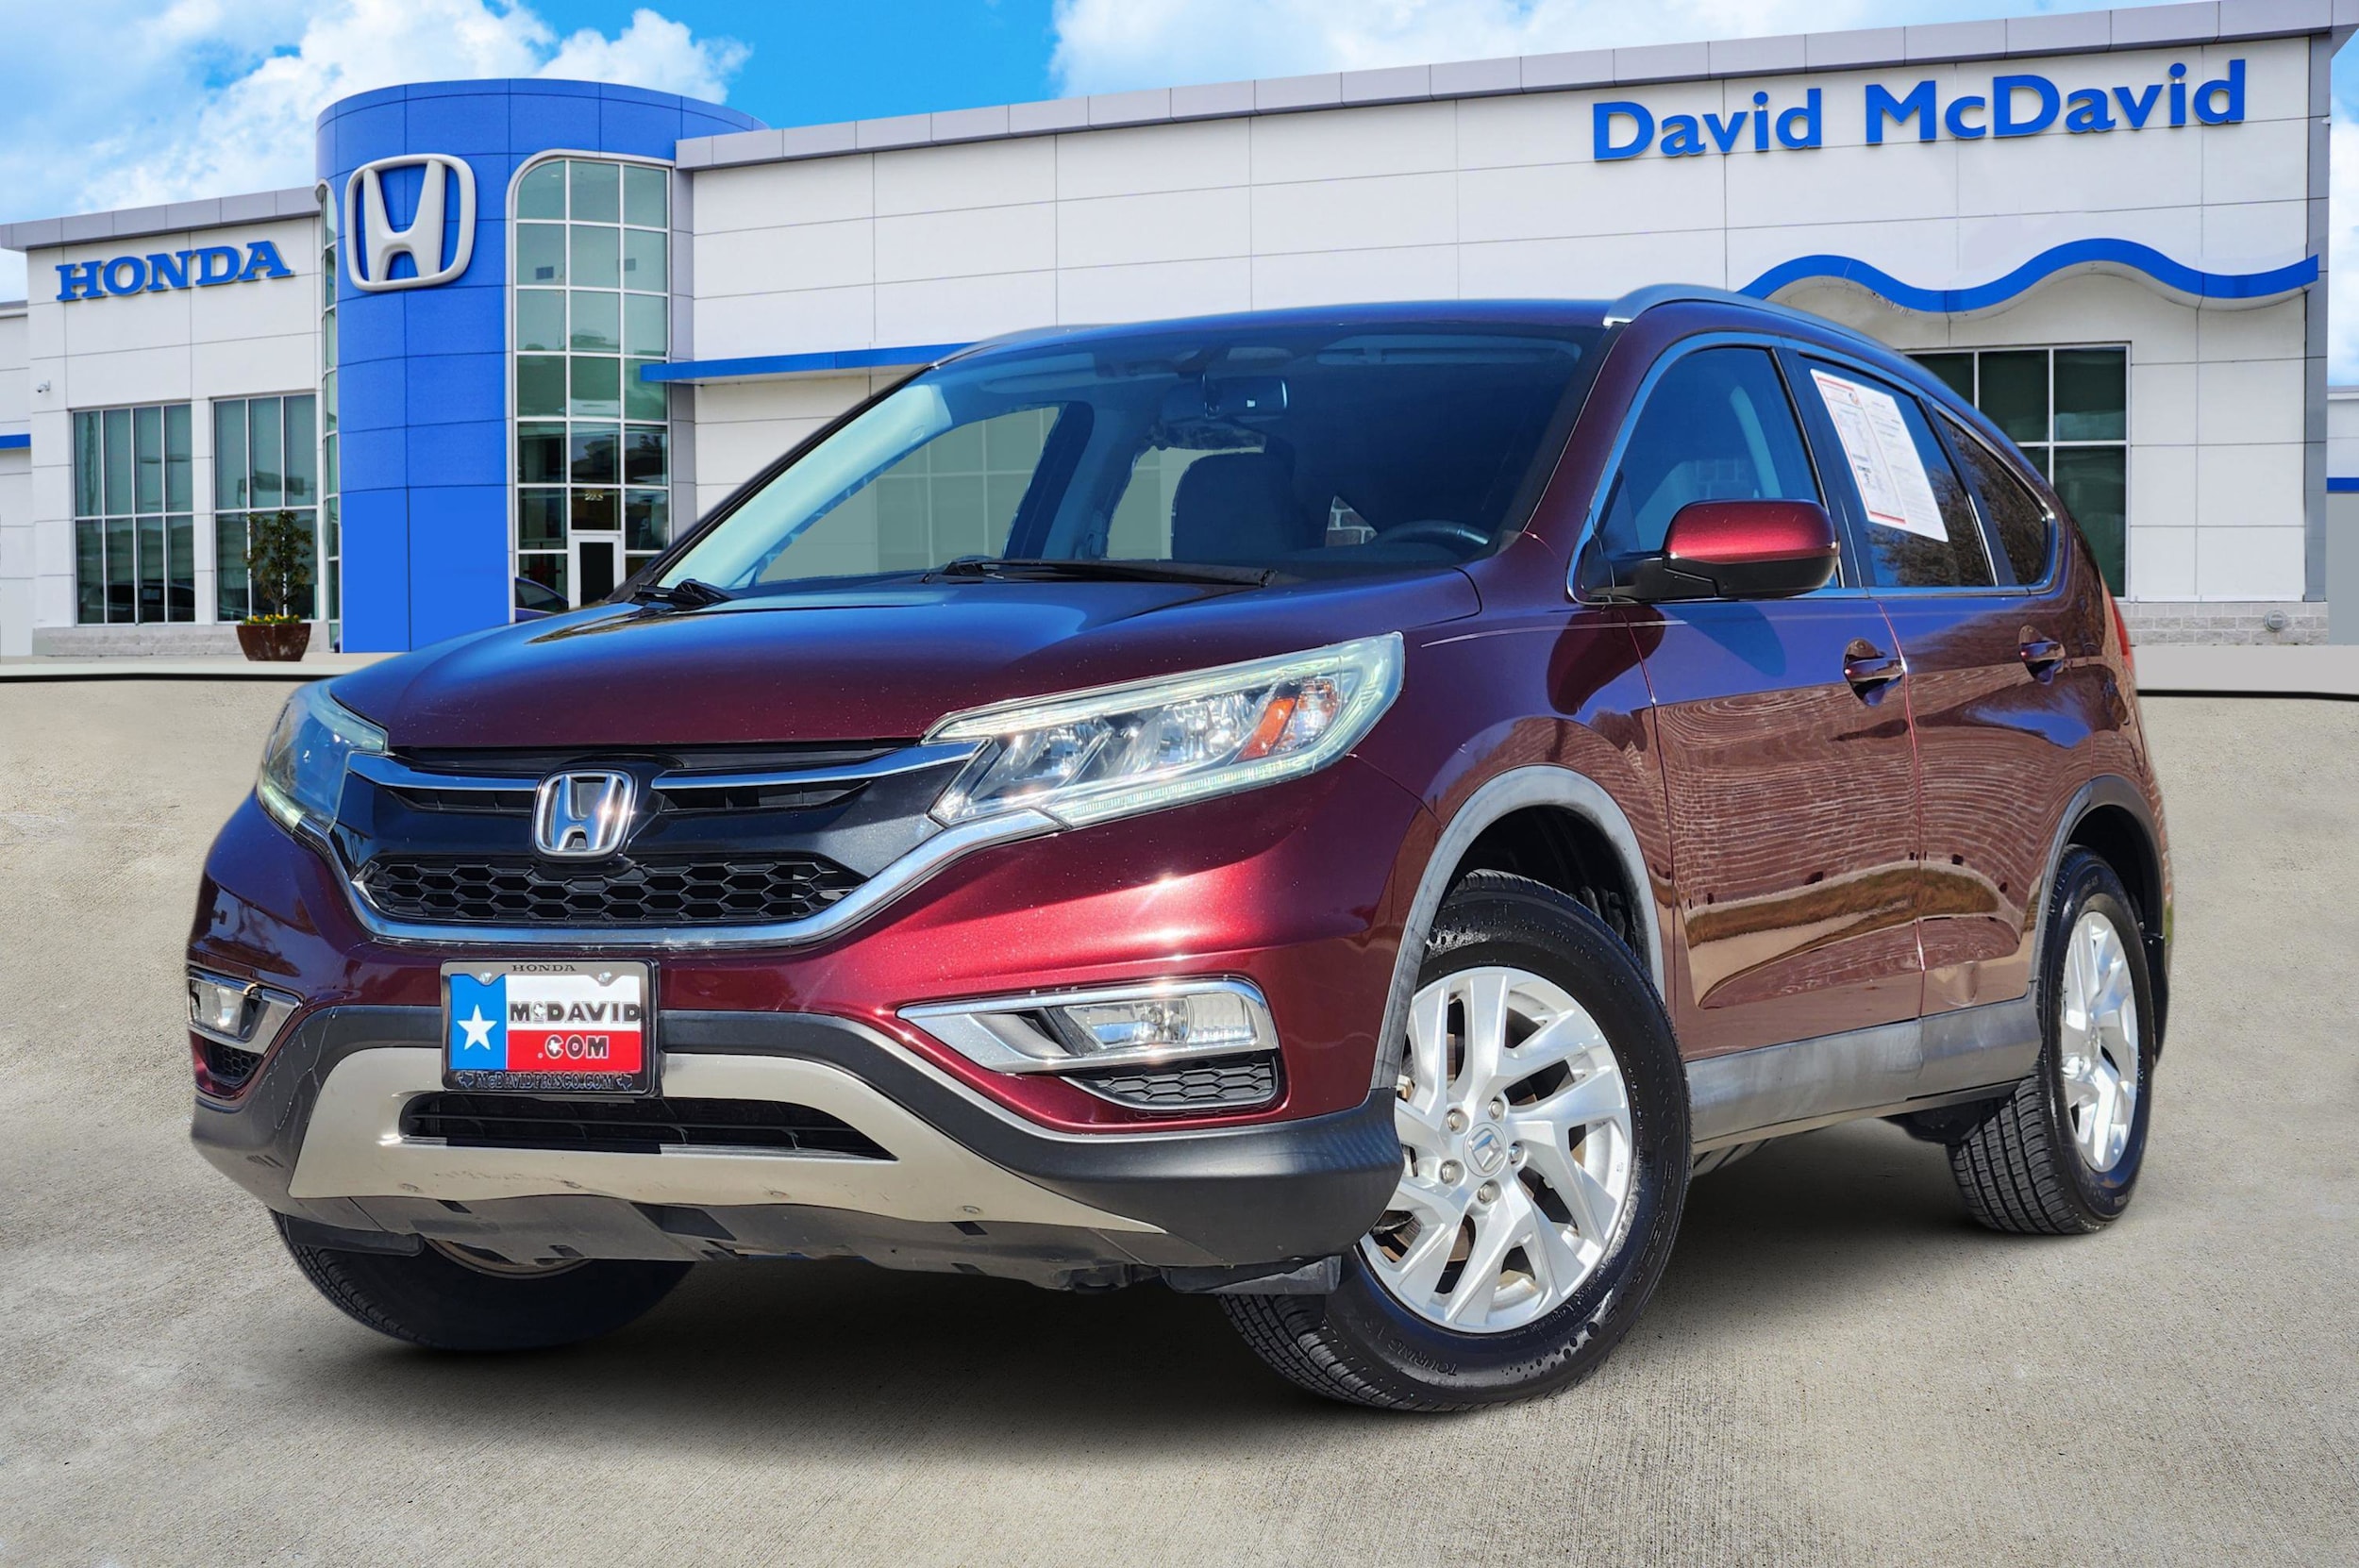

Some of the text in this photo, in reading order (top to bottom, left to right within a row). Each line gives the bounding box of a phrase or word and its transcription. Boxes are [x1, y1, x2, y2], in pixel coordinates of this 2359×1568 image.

[1594, 58, 2247, 161] David McDavid
[56, 240, 295, 302] HONDA
[512, 964, 577, 973] HONDA
